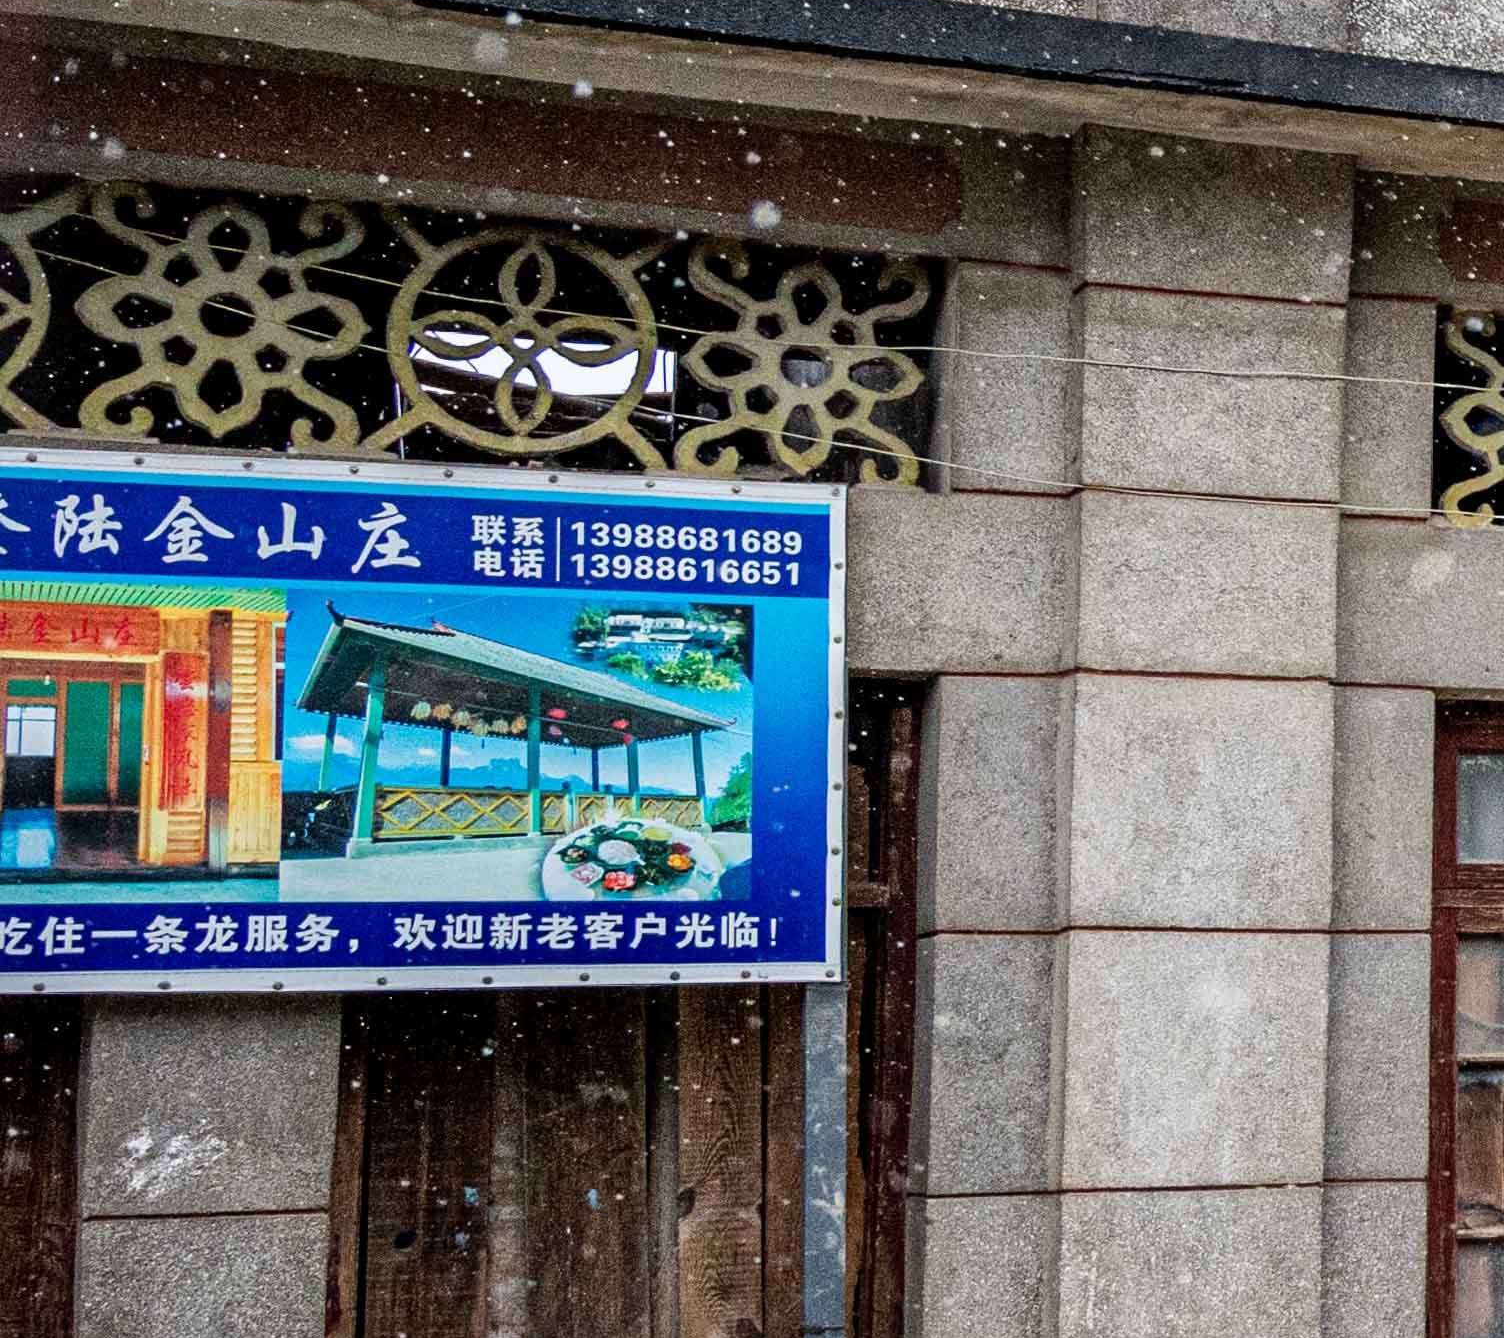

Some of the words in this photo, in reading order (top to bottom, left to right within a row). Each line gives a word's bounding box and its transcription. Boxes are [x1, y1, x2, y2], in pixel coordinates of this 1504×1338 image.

[471, 514, 545, 546] 联系
[570, 521, 802, 555] 13988681689
[472, 549, 546, 579] 电话
[569, 553, 801, 586] 13988616651
